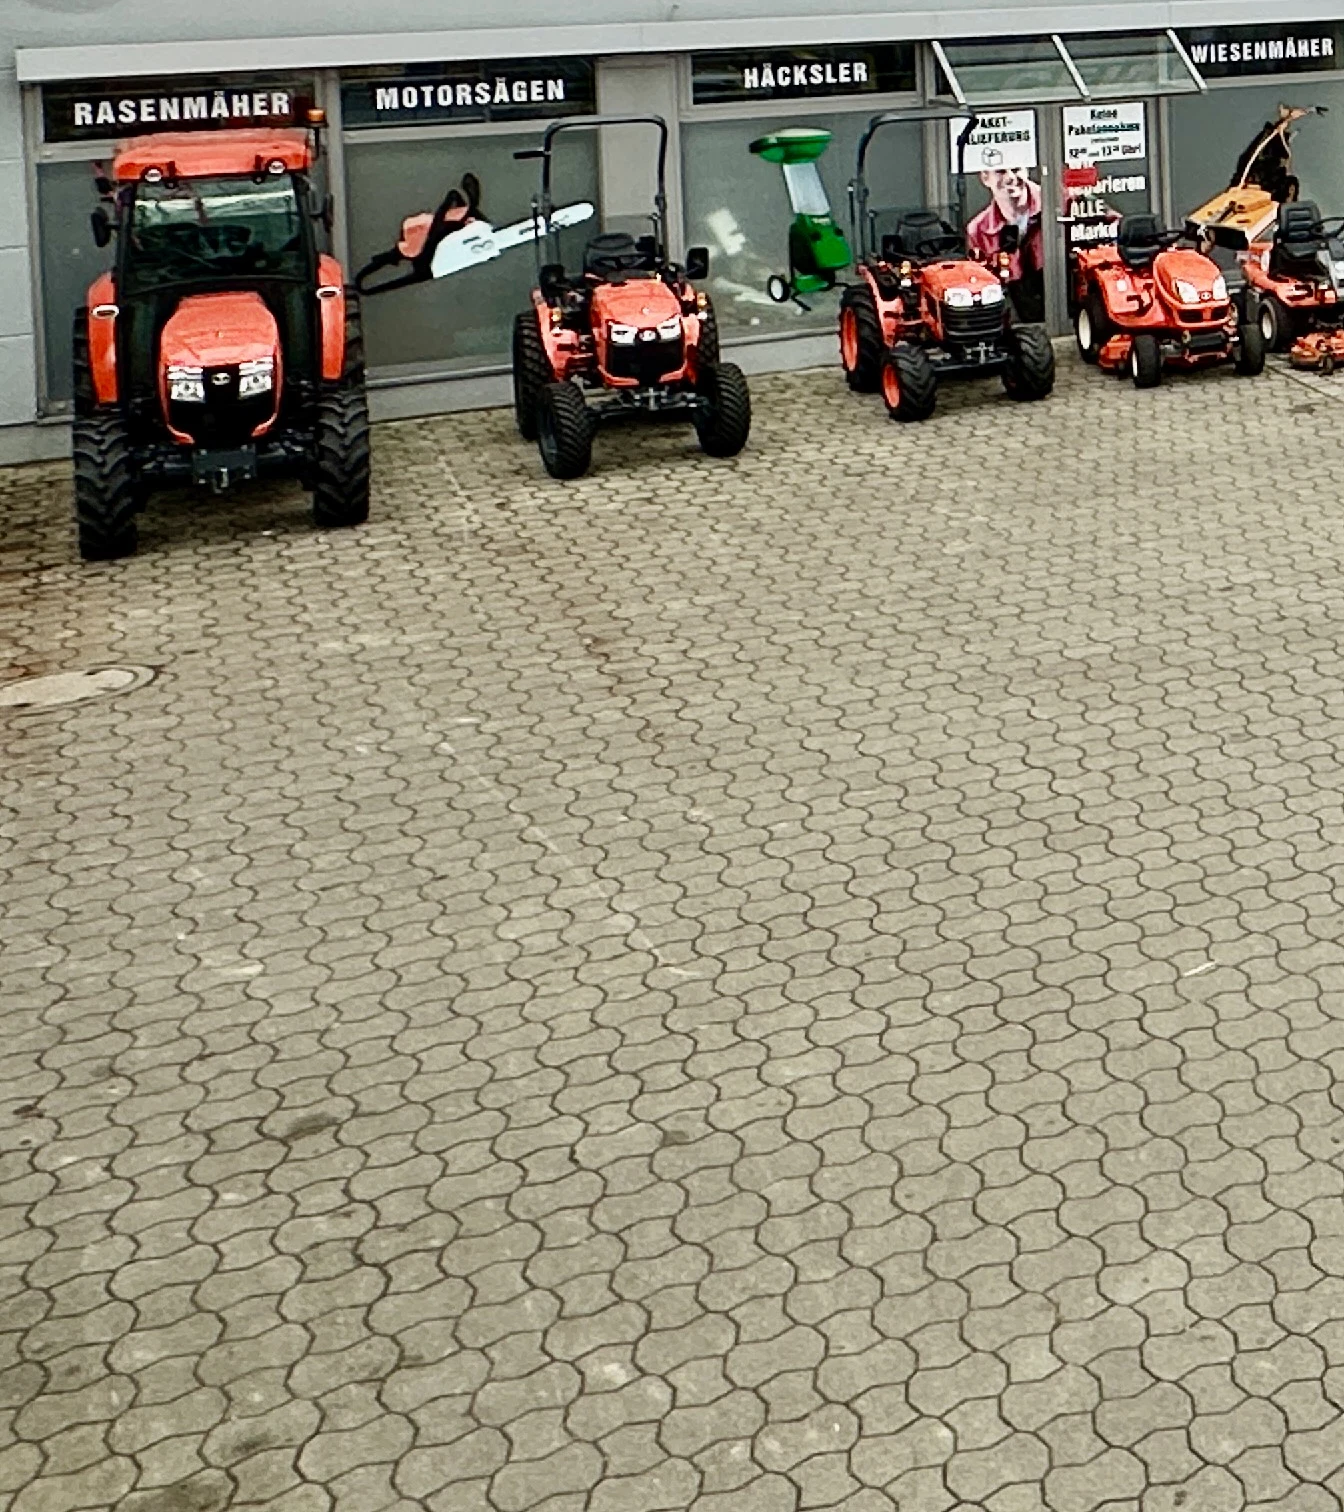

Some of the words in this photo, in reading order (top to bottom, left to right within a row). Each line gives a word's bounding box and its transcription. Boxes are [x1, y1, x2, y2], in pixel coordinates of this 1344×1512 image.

[1190, 35, 1335, 65] WIESENMÄHER
[743, 60, 869, 89] HÄCKSLER
[73, 90, 291, 127] RASENMÄHER
[375, 77, 565, 110] MOTORSÄGEN
[962, 129, 1031, 146] LIEFERUNG
